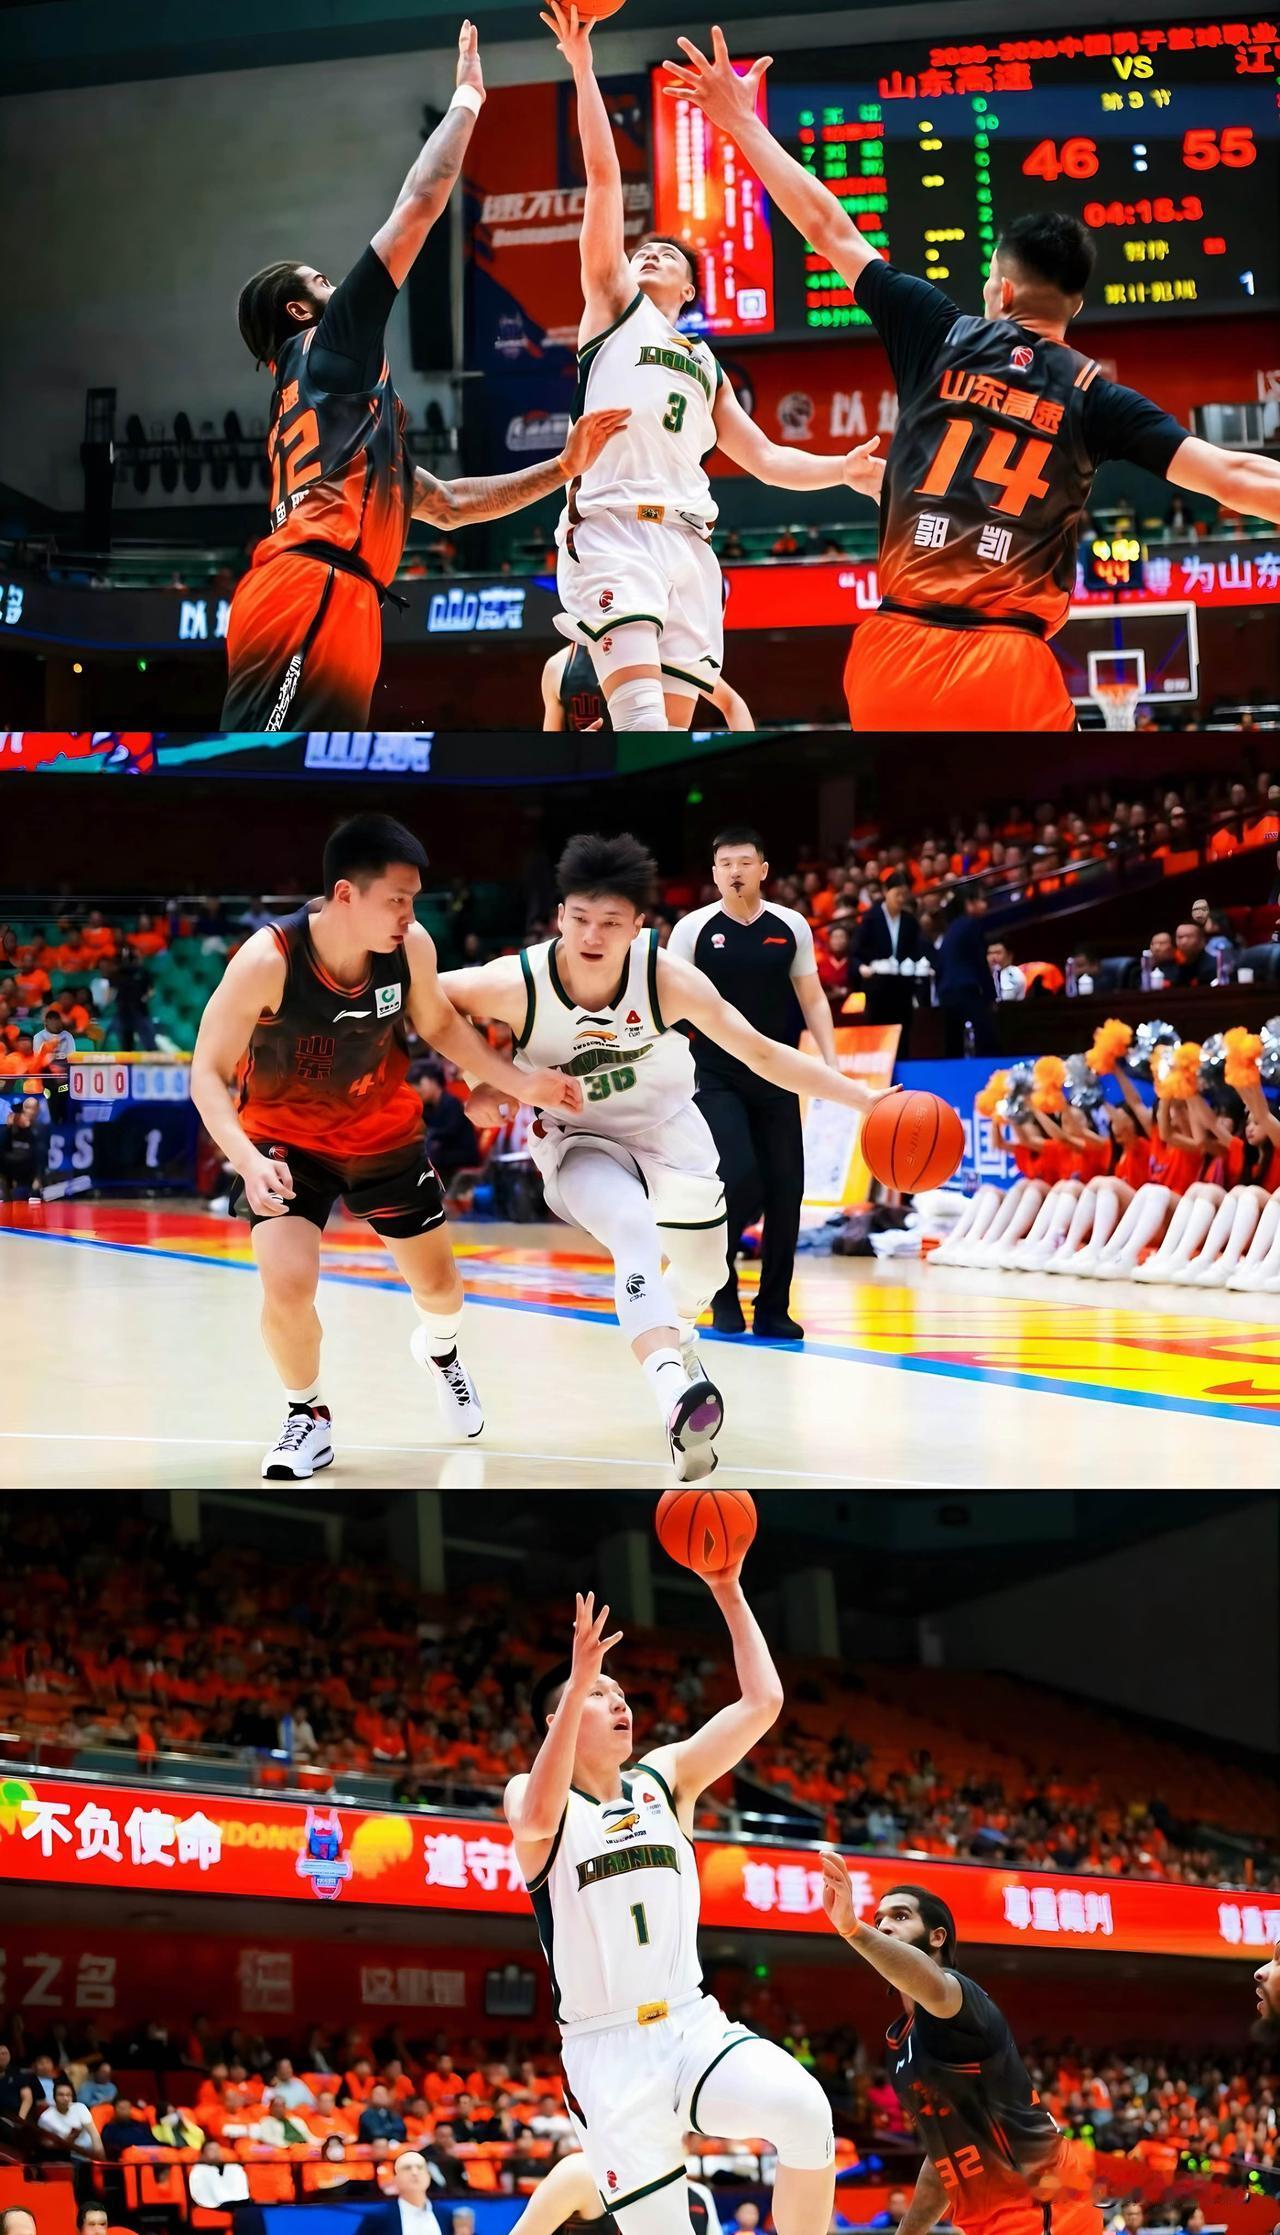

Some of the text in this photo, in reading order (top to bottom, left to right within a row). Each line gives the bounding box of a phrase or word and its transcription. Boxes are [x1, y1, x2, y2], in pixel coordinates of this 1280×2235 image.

[878, 62, 1033, 98] 山东高速
[1111, 55, 1154, 80] VS
[1235, 44, 1280, 73] 江
[1022, 137, 1099, 181] 46
[1183, 127, 1257, 171] 55
[662, 392, 687, 433] 3
[939, 369, 1065, 435] 山东高速
[913, 418, 1053, 518] 14
[21, 1799, 224, 1871] 不负使命
[630, 1902, 650, 1946] 1
[935, 2144, 985, 2190] 32
